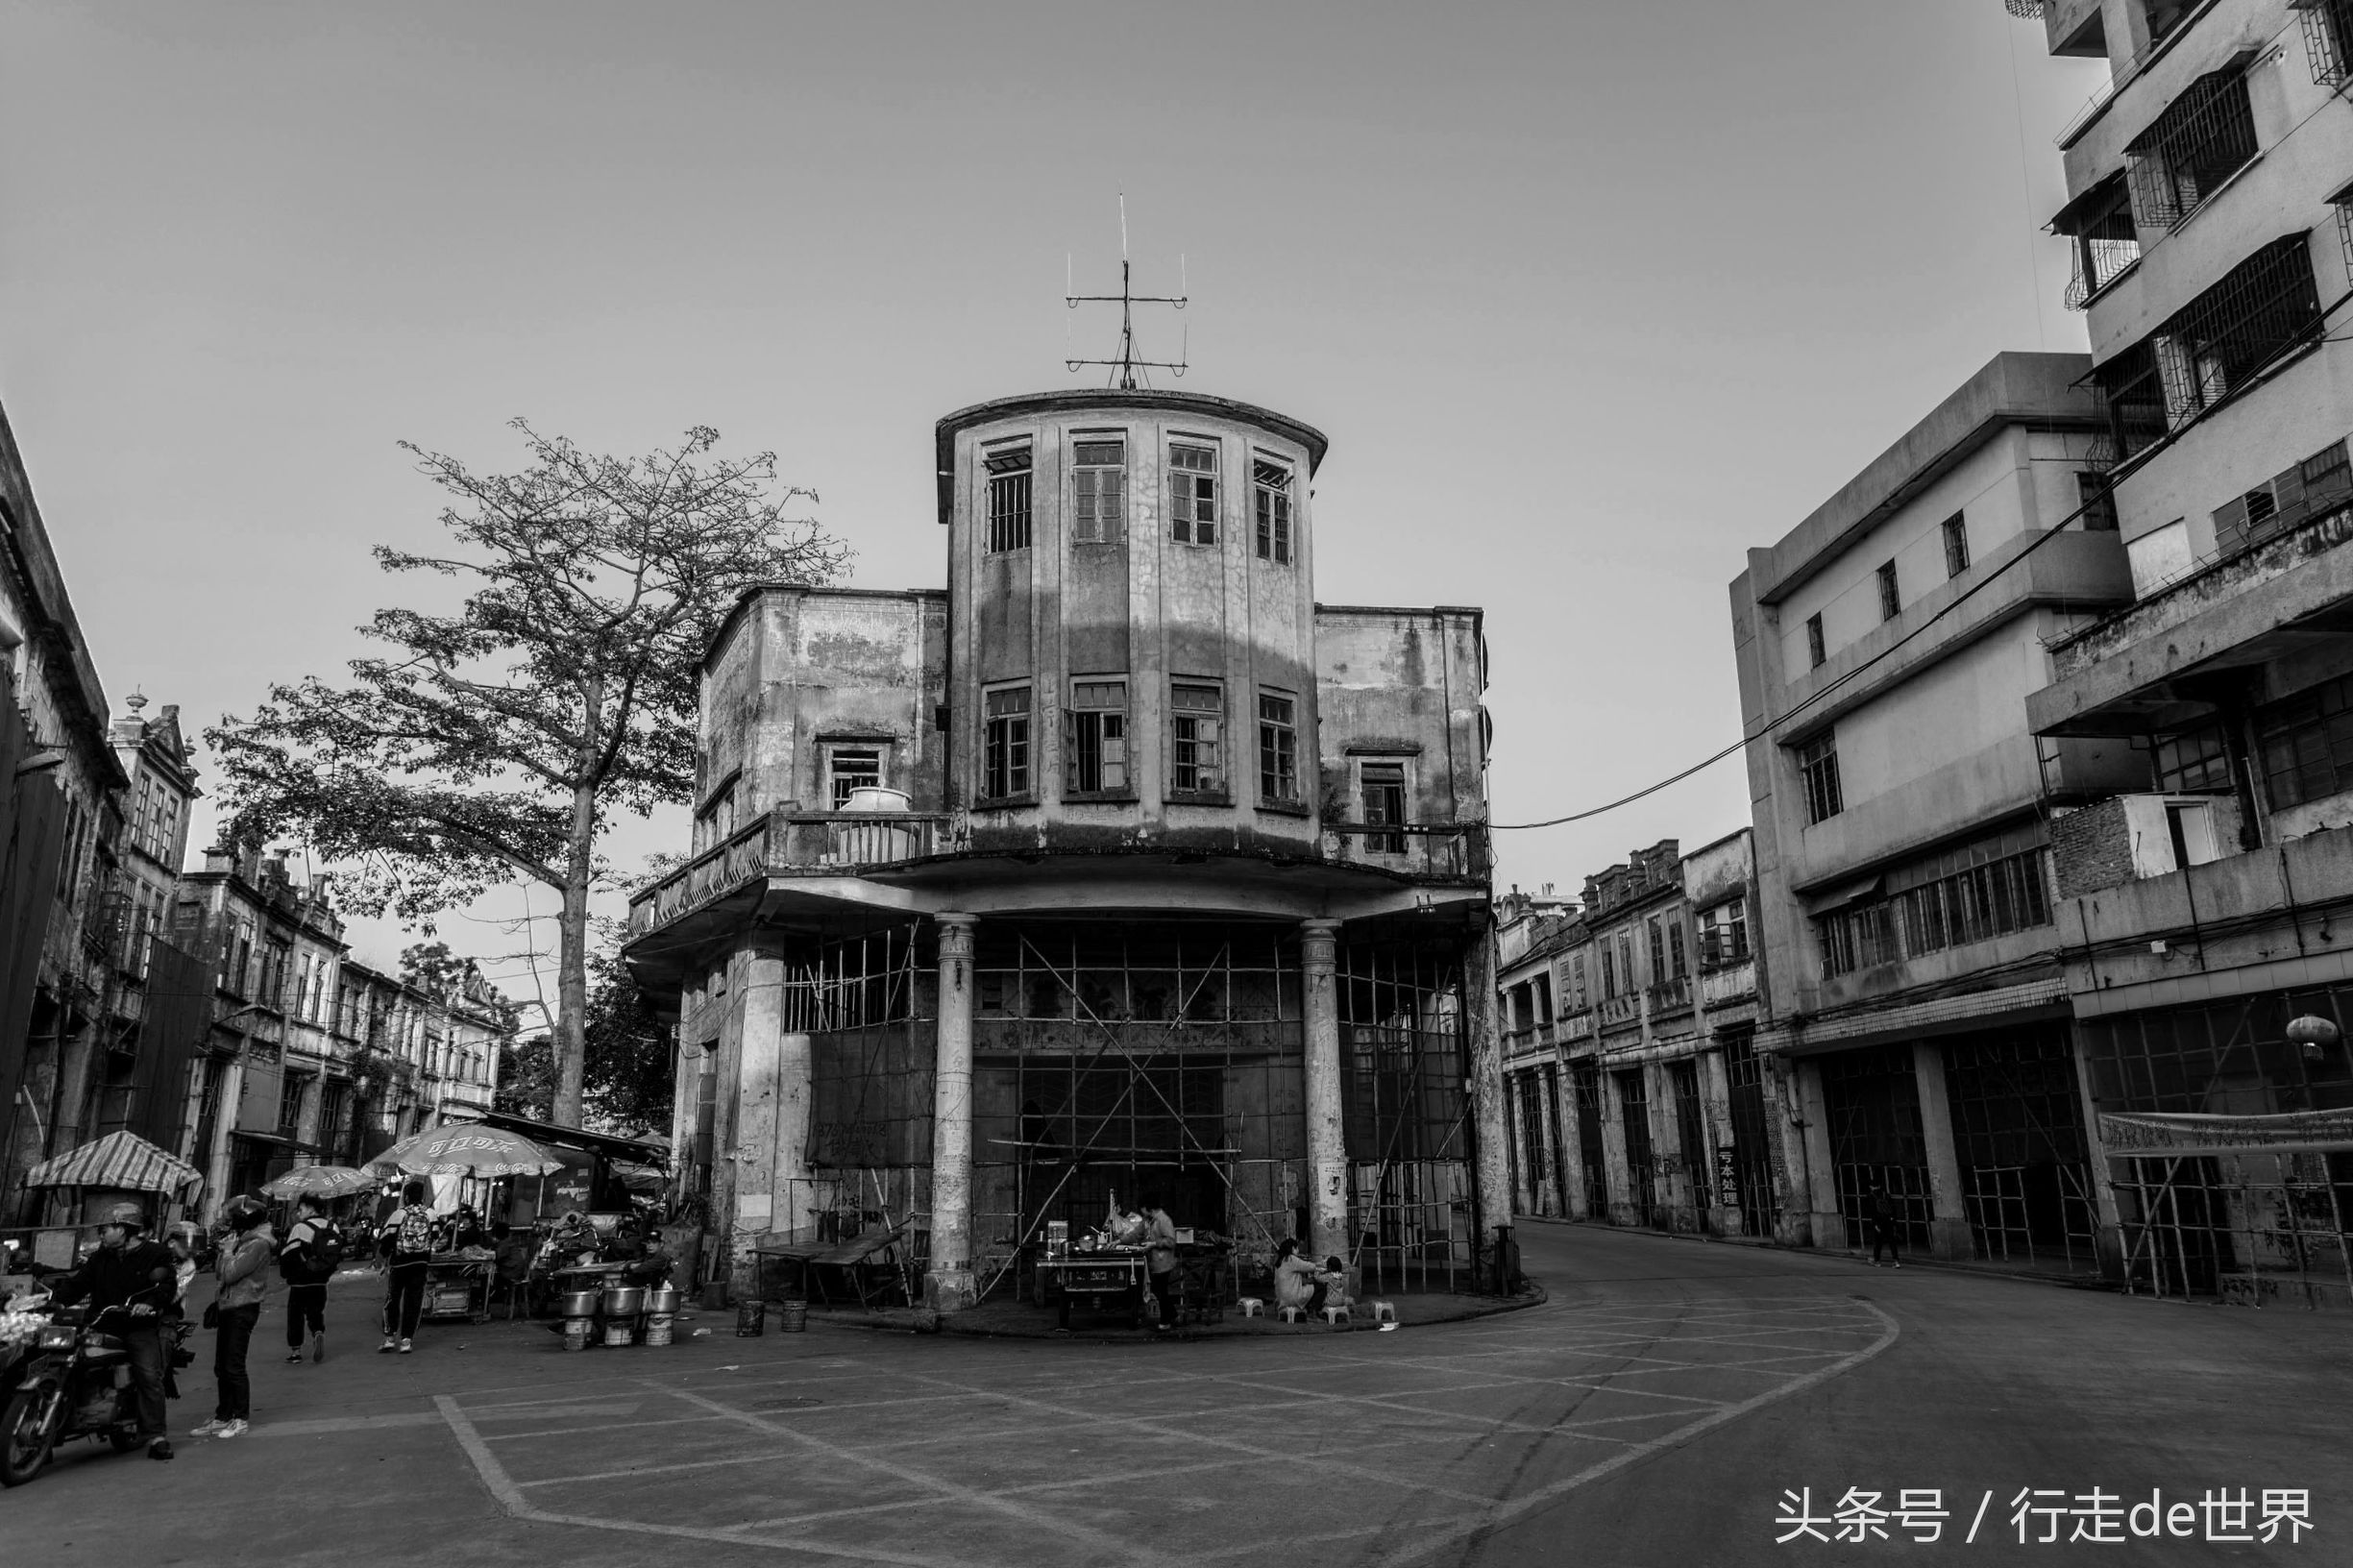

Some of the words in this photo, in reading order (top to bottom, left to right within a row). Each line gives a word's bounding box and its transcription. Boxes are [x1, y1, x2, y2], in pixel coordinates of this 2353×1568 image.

[428, 1136, 520, 1157] 可口可乐
[1718, 1151, 1739, 1205] 亏本处理
